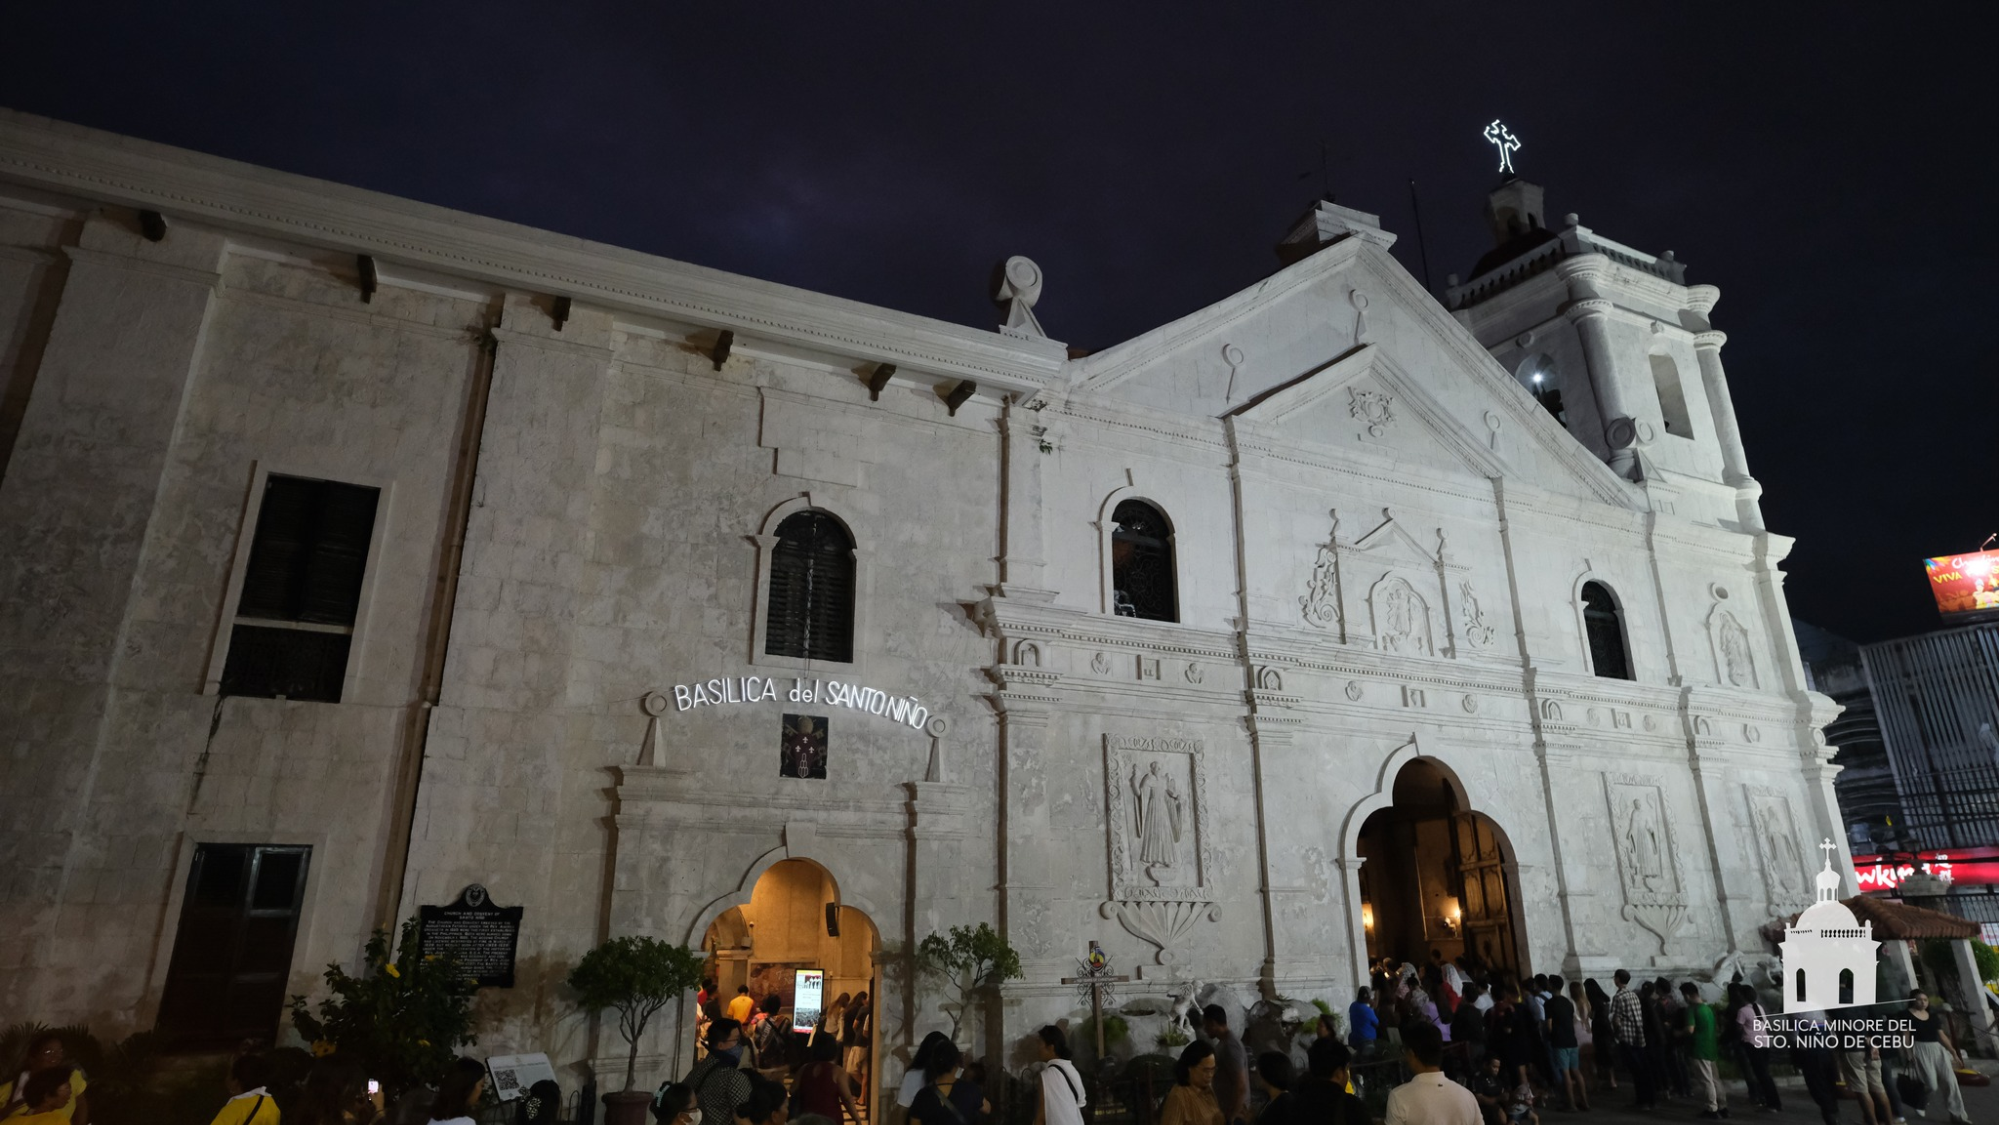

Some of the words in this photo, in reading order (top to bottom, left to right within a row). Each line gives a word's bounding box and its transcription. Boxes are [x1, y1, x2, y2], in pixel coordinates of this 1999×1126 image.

[1933, 571, 1963, 584] VIVA
[674, 676, 777, 712] BASILICA
[789, 677, 819, 704] del
[825, 680, 886, 715] SANTO
[885, 696, 928, 730] NIÑO
